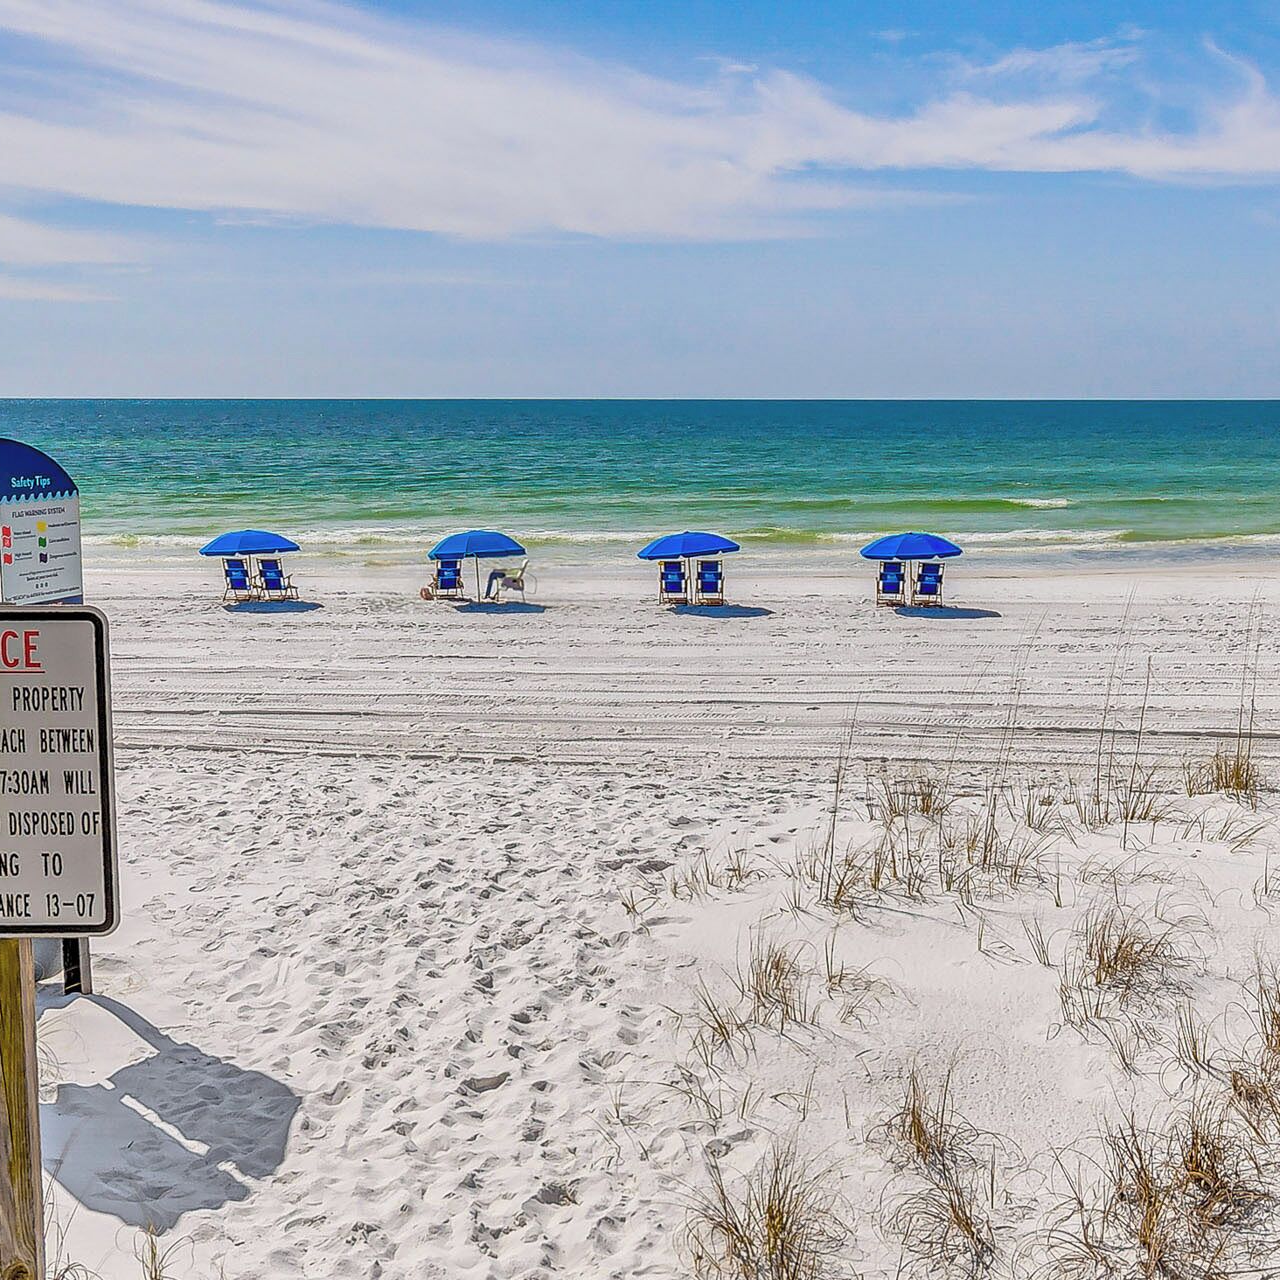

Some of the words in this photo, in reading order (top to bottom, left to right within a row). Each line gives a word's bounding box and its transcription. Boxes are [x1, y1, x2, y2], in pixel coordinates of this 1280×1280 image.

[11, 475, 35, 490] Safety
[35, 475, 51, 489] Tips
[12, 686, 85, 712] PROPERTY
[39, 728, 95, 754] BETWEEN
[0, 770, 50, 795] 7:30AM
[63, 770, 96, 795] WILL
[8, 811, 75, 836] DISPOSED
[81, 811, 100, 836] OF
[40, 852, 63, 877] TO
[45, 893, 95, 918] 13-07
